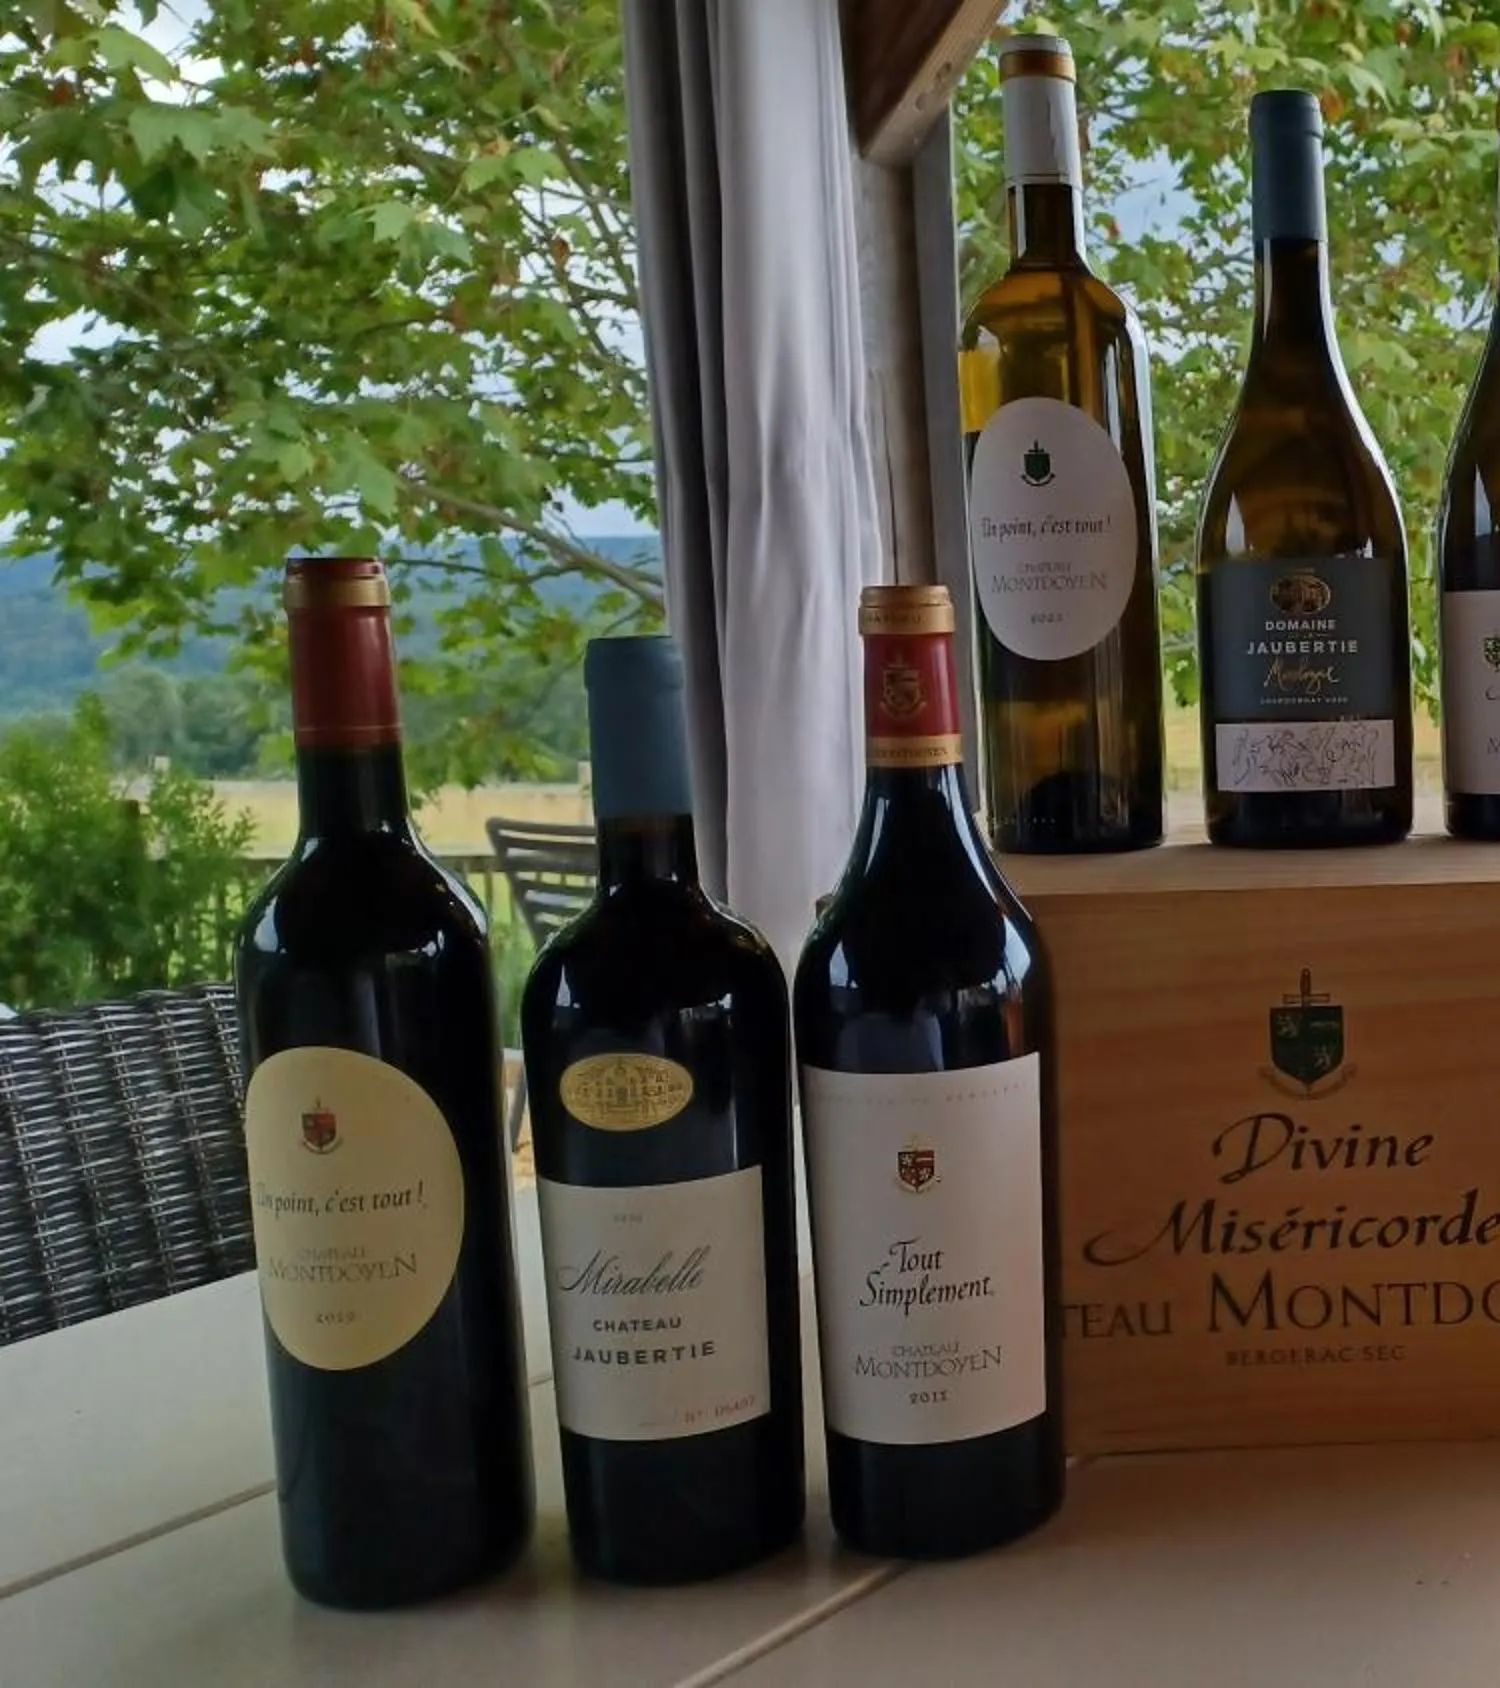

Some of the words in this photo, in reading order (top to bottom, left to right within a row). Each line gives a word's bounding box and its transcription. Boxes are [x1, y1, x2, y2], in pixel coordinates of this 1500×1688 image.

[1265, 619, 1337, 632] DOMAINE
[1247, 639, 1358, 655] JAUBERTIE
[1211, 1111, 1435, 1186] Divine
[886, 1234, 946, 1275] Tout
[556, 1244, 712, 1298] Mirabelle
[592, 1316, 684, 1334] CHATEAU
[1057, 1300, 1174, 1340] TEAU
[572, 1340, 718, 1367] JAUBERTIE
[854, 1343, 1003, 1381] MONTDOYEN
[1225, 1345, 1355, 1367] BERGERAC
